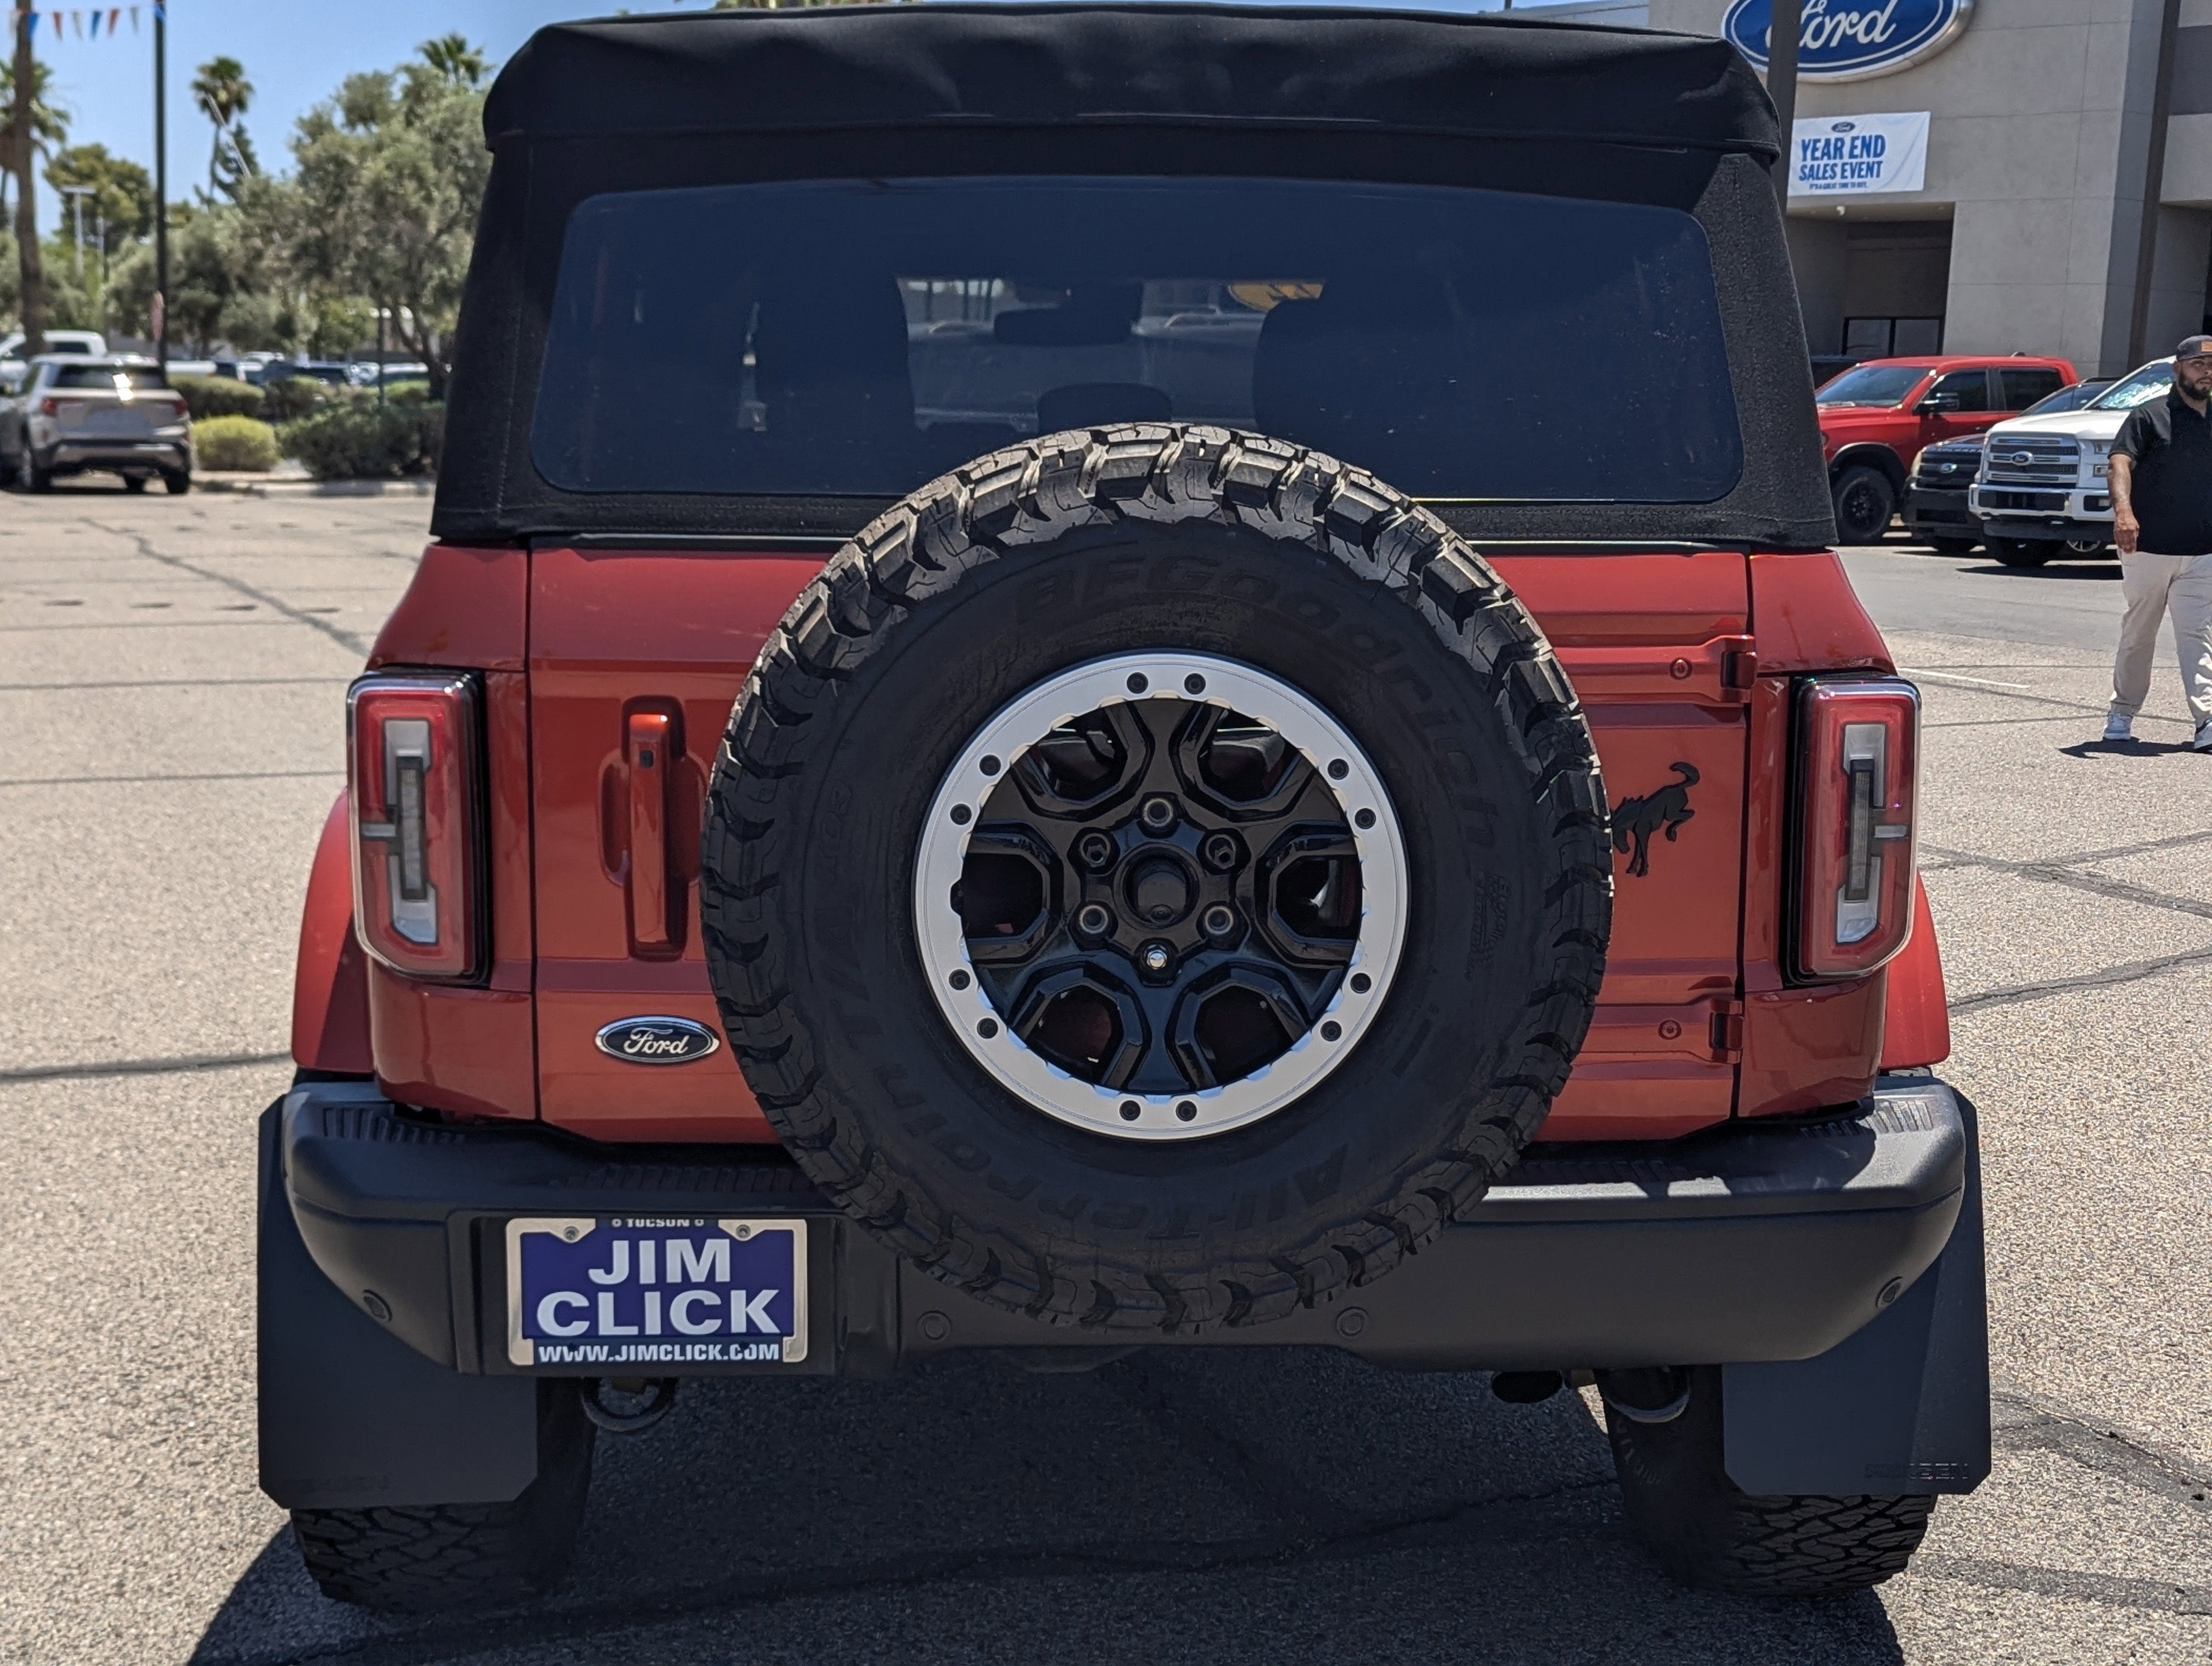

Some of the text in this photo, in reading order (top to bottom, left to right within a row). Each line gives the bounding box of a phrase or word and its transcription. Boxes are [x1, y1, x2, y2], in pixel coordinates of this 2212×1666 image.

[1765, 0, 1896, 49] ord
[1801, 134, 1886, 162] YEAR END
[1799, 161, 1883, 181] SALES EVENT
[623, 1028, 690, 1054] Ford
[627, 1219, 690, 1228] TUCSON
[588, 1239, 730, 1285] JIM
[537, 1290, 780, 1336] CLICK
[538, 1344, 780, 1363] WWW.JIMCLICK.COM
